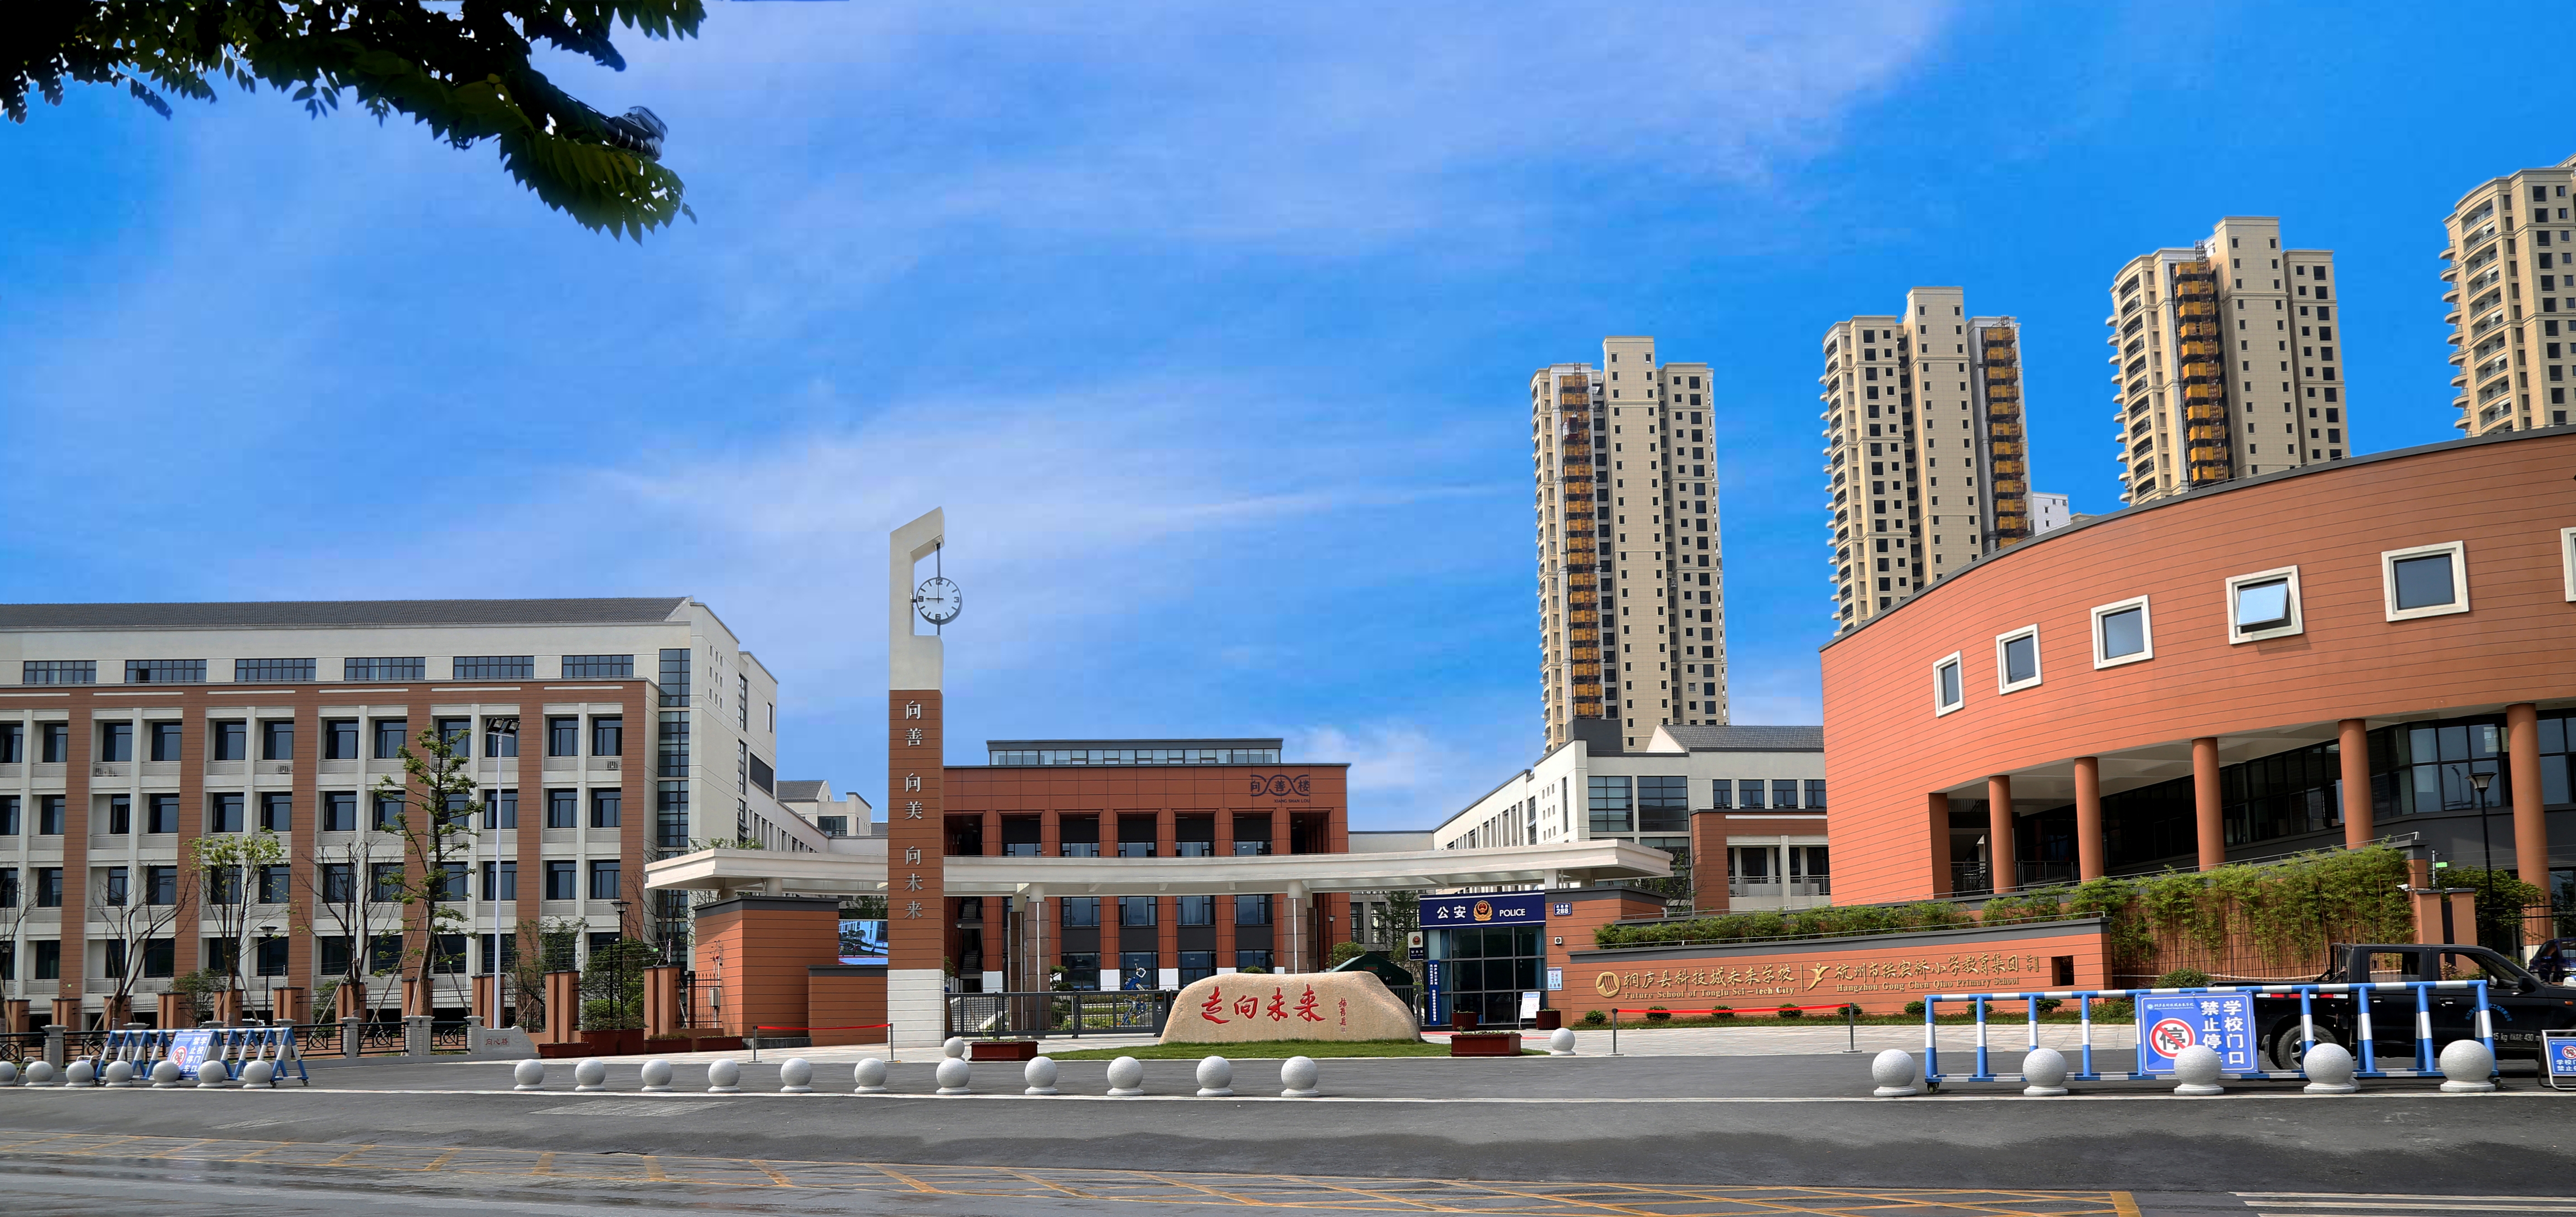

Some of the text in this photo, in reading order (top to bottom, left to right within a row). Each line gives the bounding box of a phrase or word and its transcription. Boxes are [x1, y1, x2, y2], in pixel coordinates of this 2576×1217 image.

[1250, 780, 1310, 792] 向善楼
[904, 700, 923, 920] 向善 向美 向未来
[1437, 905, 1466, 919] 公安
[1499, 908, 1526, 917] POLICE
[1623, 964, 1795, 991] 桐庐县科技城未来学校
[1834, 953, 2018, 983] 杭州市拱宸桥小学教育集团
[1701, 989, 1729, 998] Tonglu
[1776, 986, 1794, 995] City
[1837, 984, 1878, 993] Hangzhou
[1882, 982, 1905, 991] Gong
[1933, 980, 1953, 990] Qiao
[1957, 979, 1991, 988] Primary
[1994, 977, 2019, 985] School
[1201, 984, 1326, 1024] 走向未来
[2201, 1001, 2223, 1062] 禁止停
[2223, 1000, 2245, 1064] 学校门口
[2501, 1033, 2508, 1042] kg
[183, 1037, 200, 1073] 禁止停车
[190, 1036, 208, 1073] 学校门口
